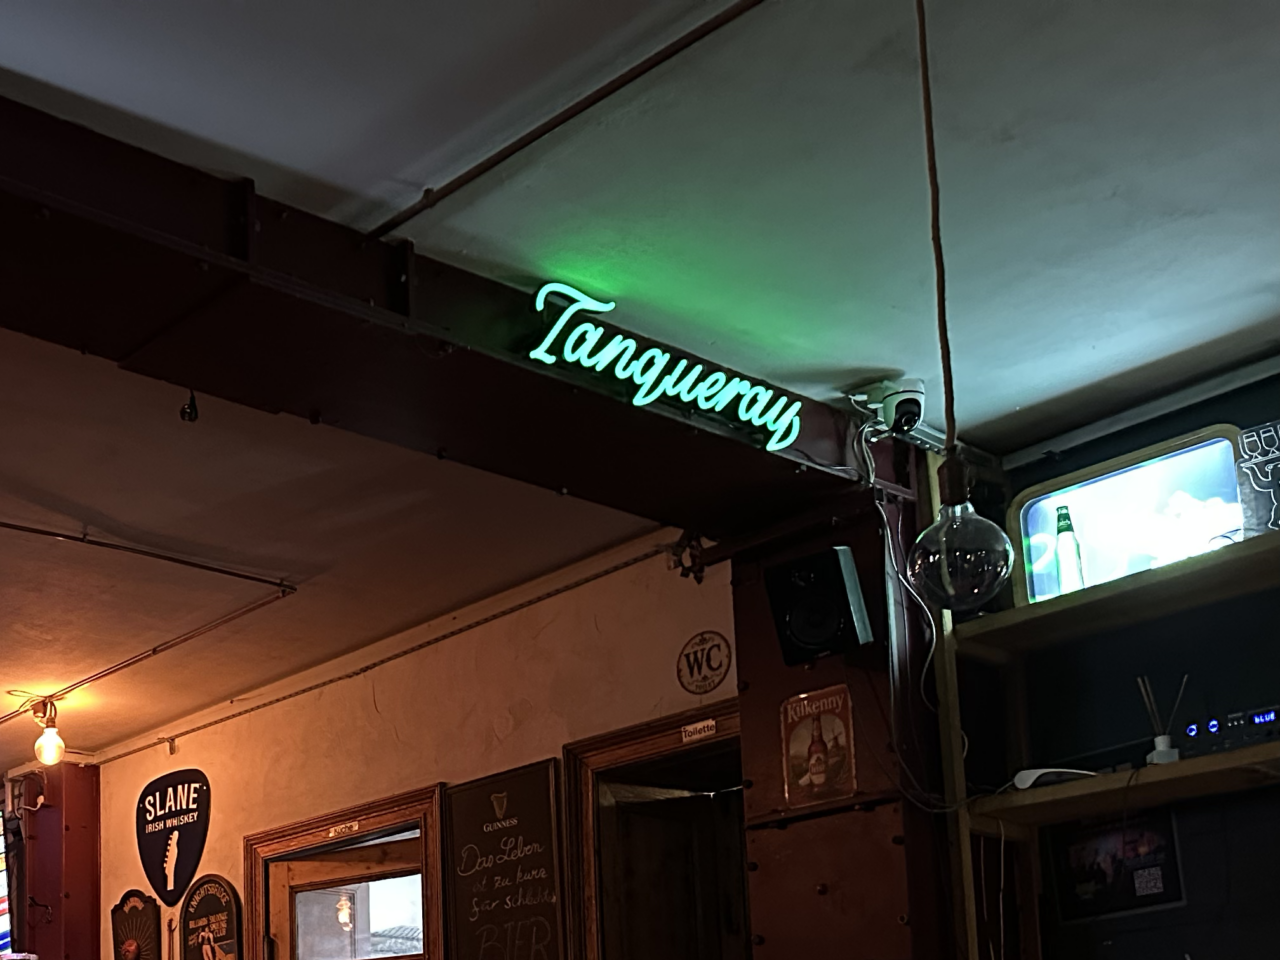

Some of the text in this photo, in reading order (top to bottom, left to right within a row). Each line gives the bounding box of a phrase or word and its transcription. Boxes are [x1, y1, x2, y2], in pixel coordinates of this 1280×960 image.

[529, 282, 802, 451] Tanqueray
[684, 644, 722, 678] WC
[787, 693, 845, 723] Kilkenny
[683, 723, 715, 739] Toilette
[145, 783, 199, 821] SLANE
[146, 812, 198, 833] IRISH WHISKEY
[483, 817, 519, 833] GUINNESS
[494, 875, 512, 890] zu
[515, 864, 548, 885] kurz
